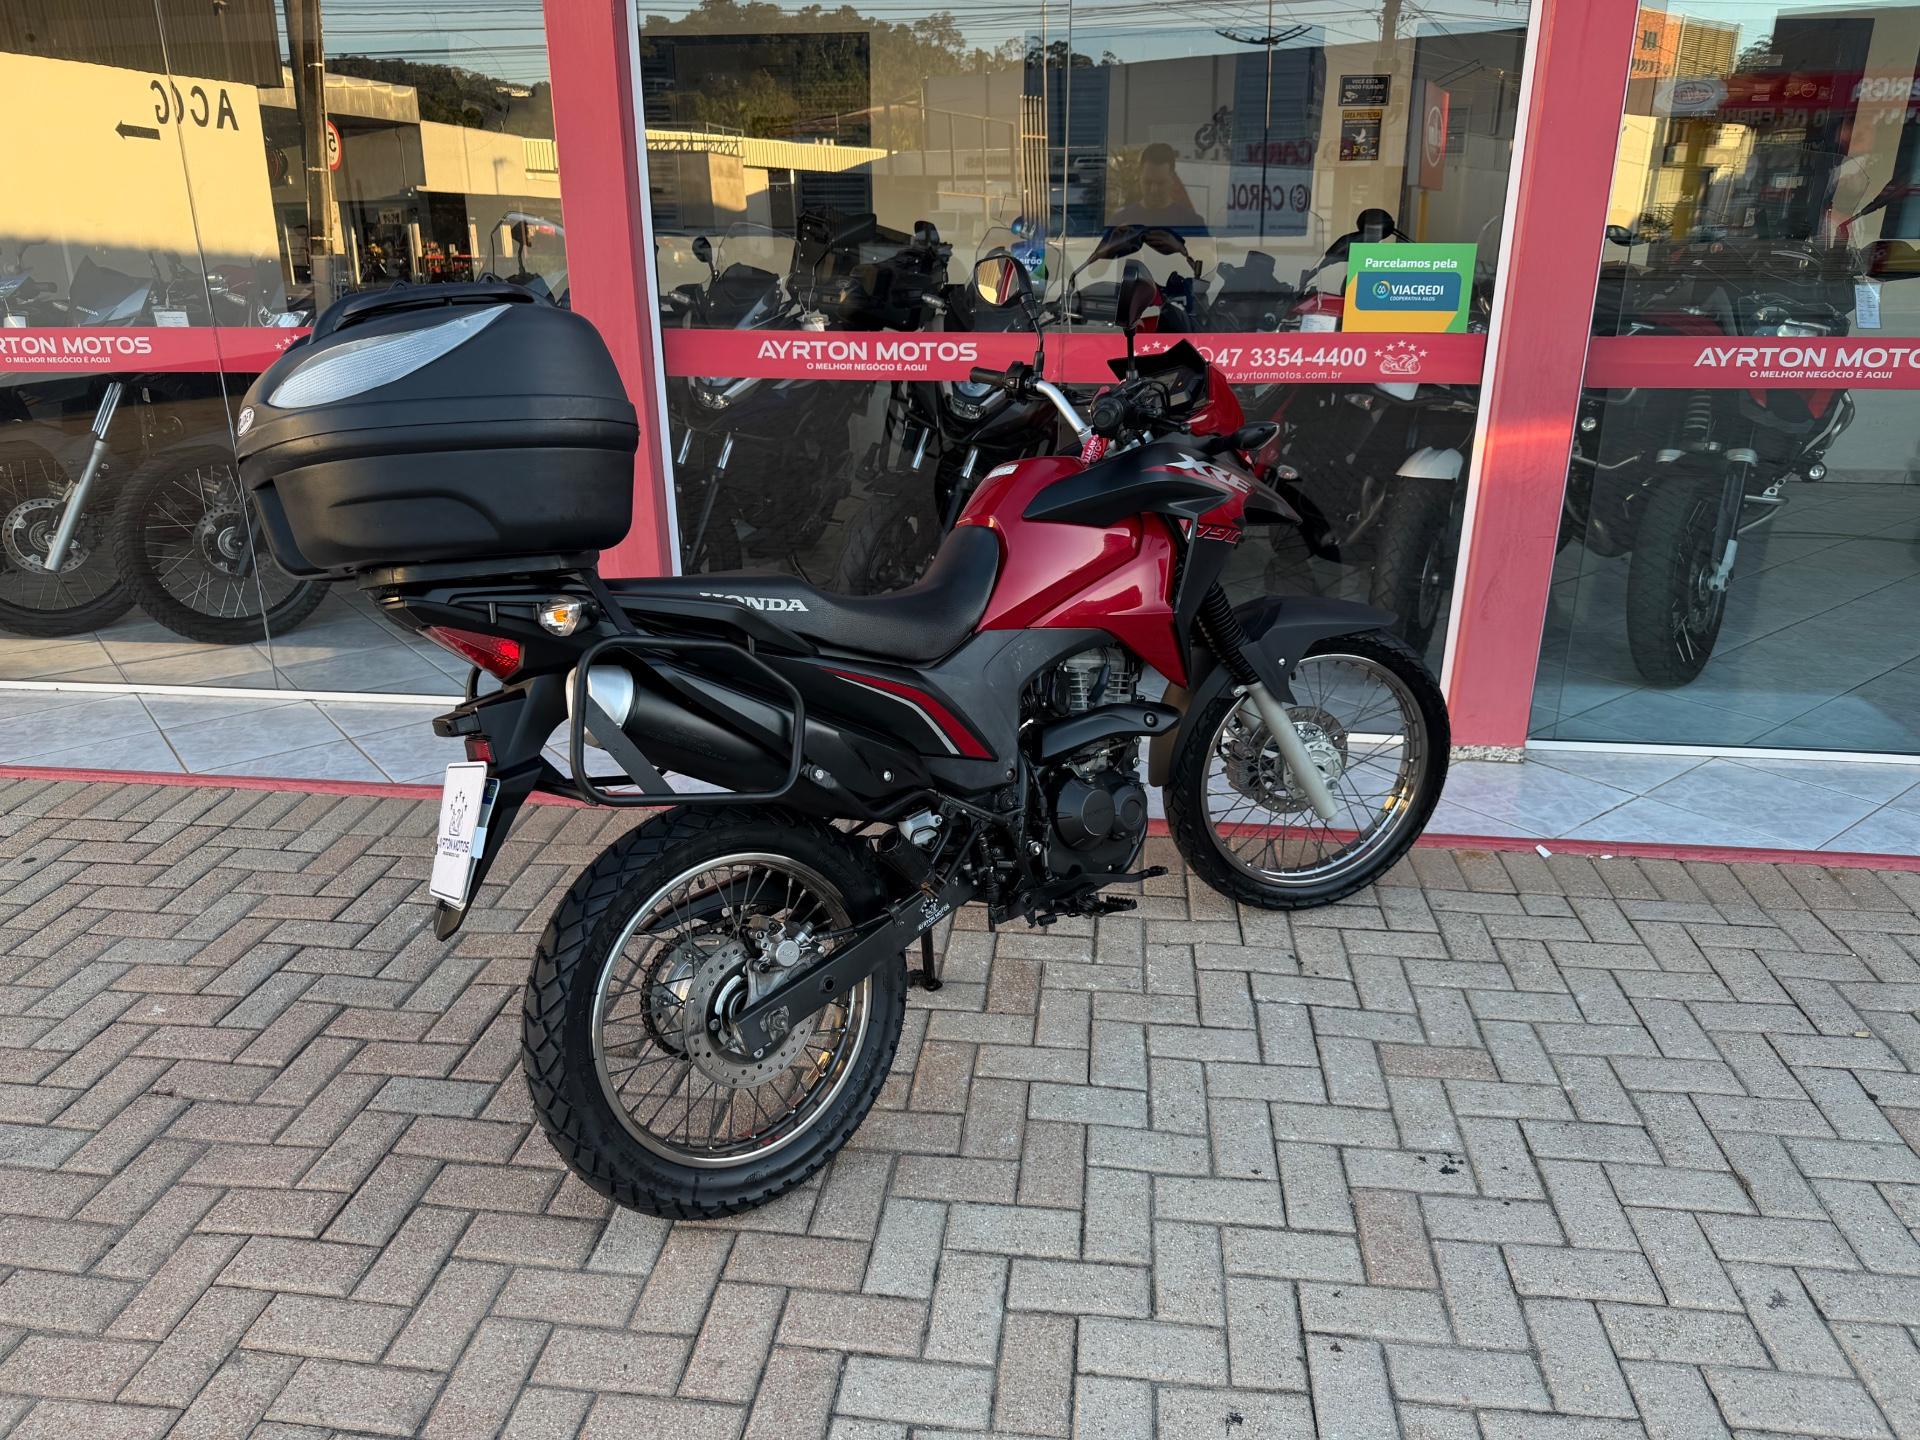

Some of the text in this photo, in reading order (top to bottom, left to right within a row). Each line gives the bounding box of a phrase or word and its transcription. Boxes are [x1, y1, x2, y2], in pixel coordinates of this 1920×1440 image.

[1365, 258, 1458, 270] Parcelamos pela
[1391, 285, 1444, 296] VIACREDI
[62, 336, 152, 354] MOTOS
[757, 340, 978, 362] AYRTON MOTOS
[47, 355, 82, 363] NEGÓCIO
[1216, 347, 1367, 367] 47 3354-4400
[1693, 347, 1827, 368] AYRTON
[806, 362, 928, 372] O MELHOR NEGÓCIO É AQUI
[1749, 369, 1893, 379] O MELHOR NEGÓCIO É AQUI
[1164, 452, 1251, 494] XRE
[699, 591, 809, 612] NDA
